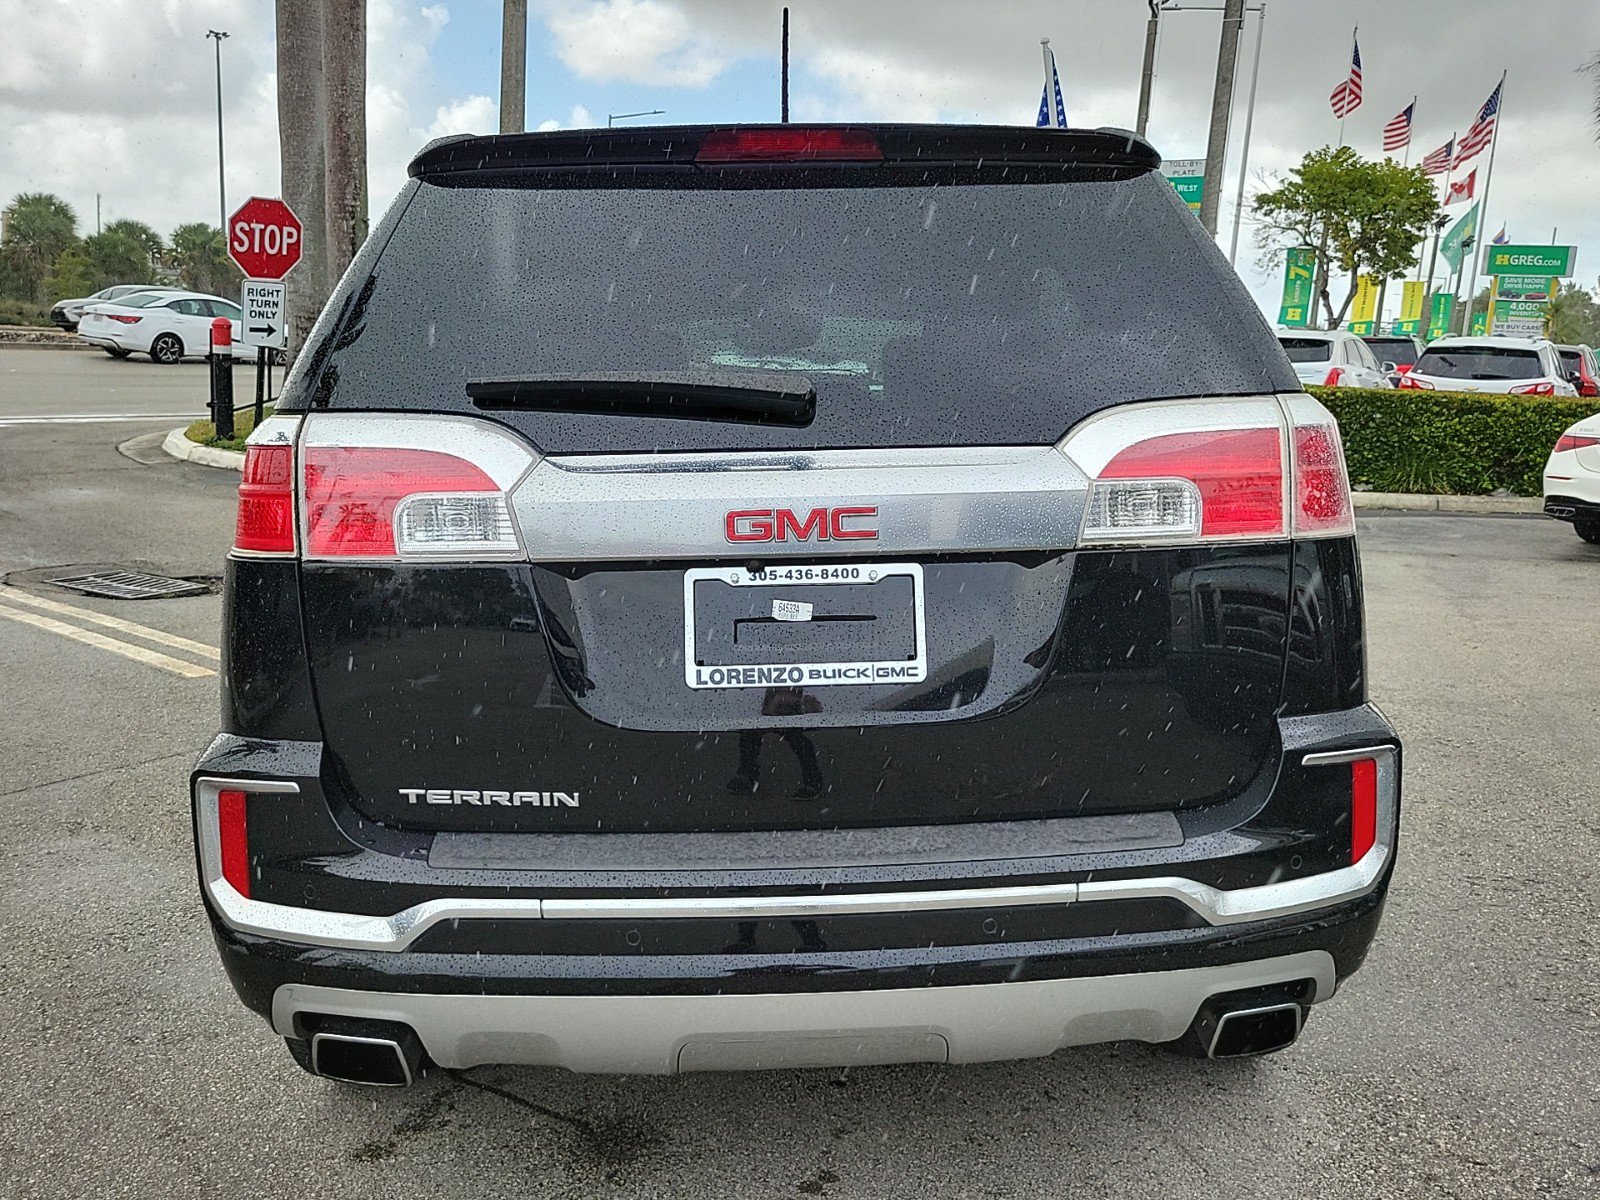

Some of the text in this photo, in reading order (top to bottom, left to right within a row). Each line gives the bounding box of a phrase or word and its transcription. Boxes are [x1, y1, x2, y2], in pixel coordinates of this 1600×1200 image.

[1177, 184, 1198, 192] WEST
[233, 221, 298, 256] STOP
[247, 287, 282, 299] RIGHT
[249, 298, 280, 309] TURN
[249, 309, 278, 320] ONLY
[1506, 323, 1521, 331] BUY
[724, 505, 879, 543] GMC
[749, 567, 860, 581] 305-436-8400
[696, 666, 804, 685] LORENZO
[398, 787, 580, 808] TERRAIN
